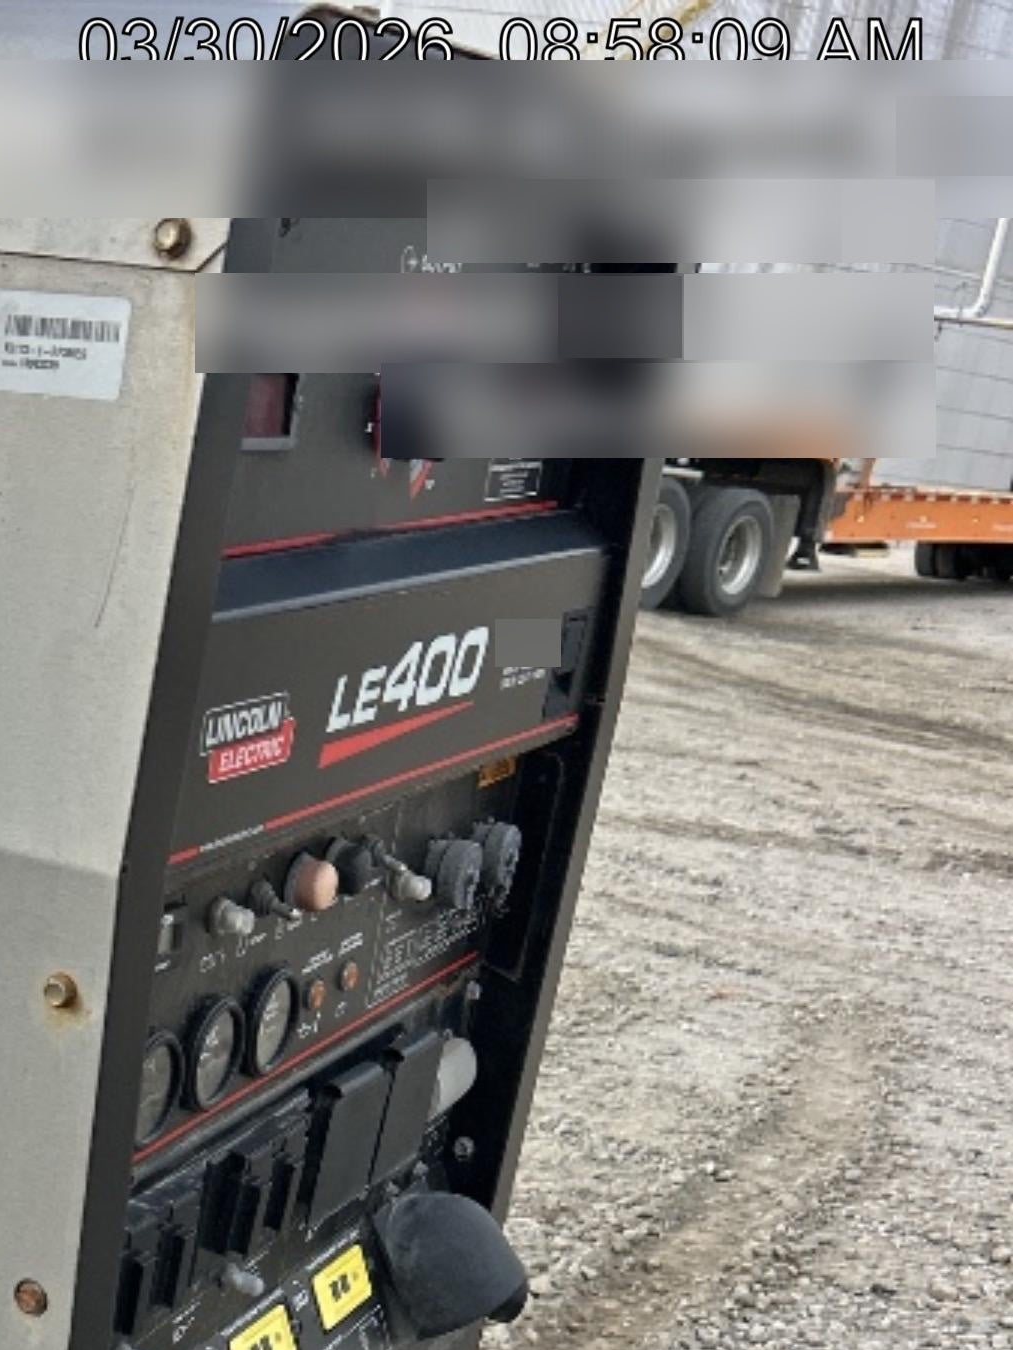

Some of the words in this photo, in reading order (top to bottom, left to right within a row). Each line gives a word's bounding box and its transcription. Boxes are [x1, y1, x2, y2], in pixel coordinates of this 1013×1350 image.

[325, 625, 489, 734] LE400
[204, 701, 285, 747] LINCOLN
[218, 735, 287, 773] ELECTRIC
